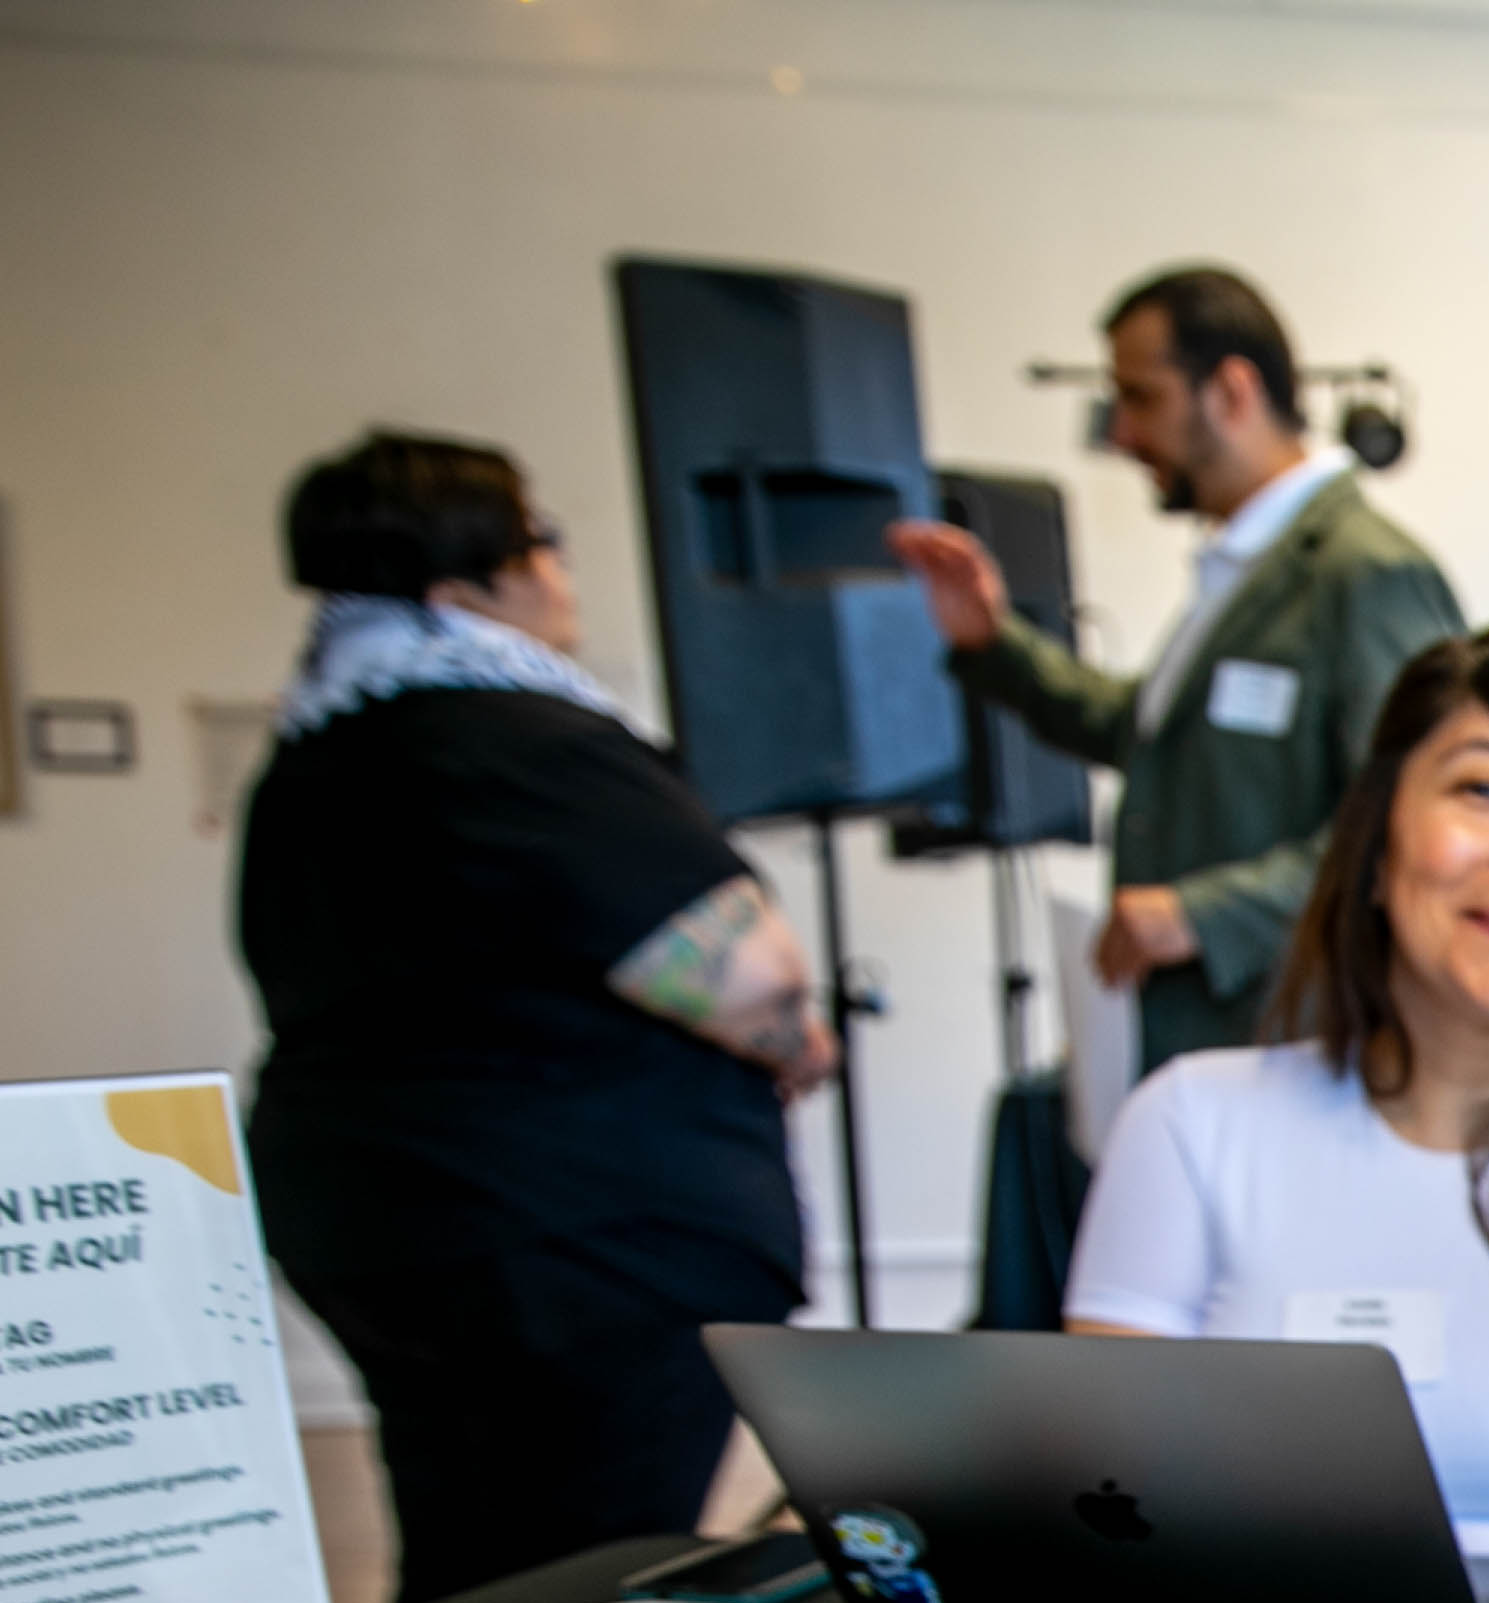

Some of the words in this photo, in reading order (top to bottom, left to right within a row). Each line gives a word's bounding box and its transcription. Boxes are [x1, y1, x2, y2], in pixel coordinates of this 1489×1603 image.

[30, 1178, 149, 1223] HERE
[0, 1320, 53, 1350] AG
[0, 1394, 150, 1440] COMFORT
[155, 1382, 245, 1416] LEVEL
